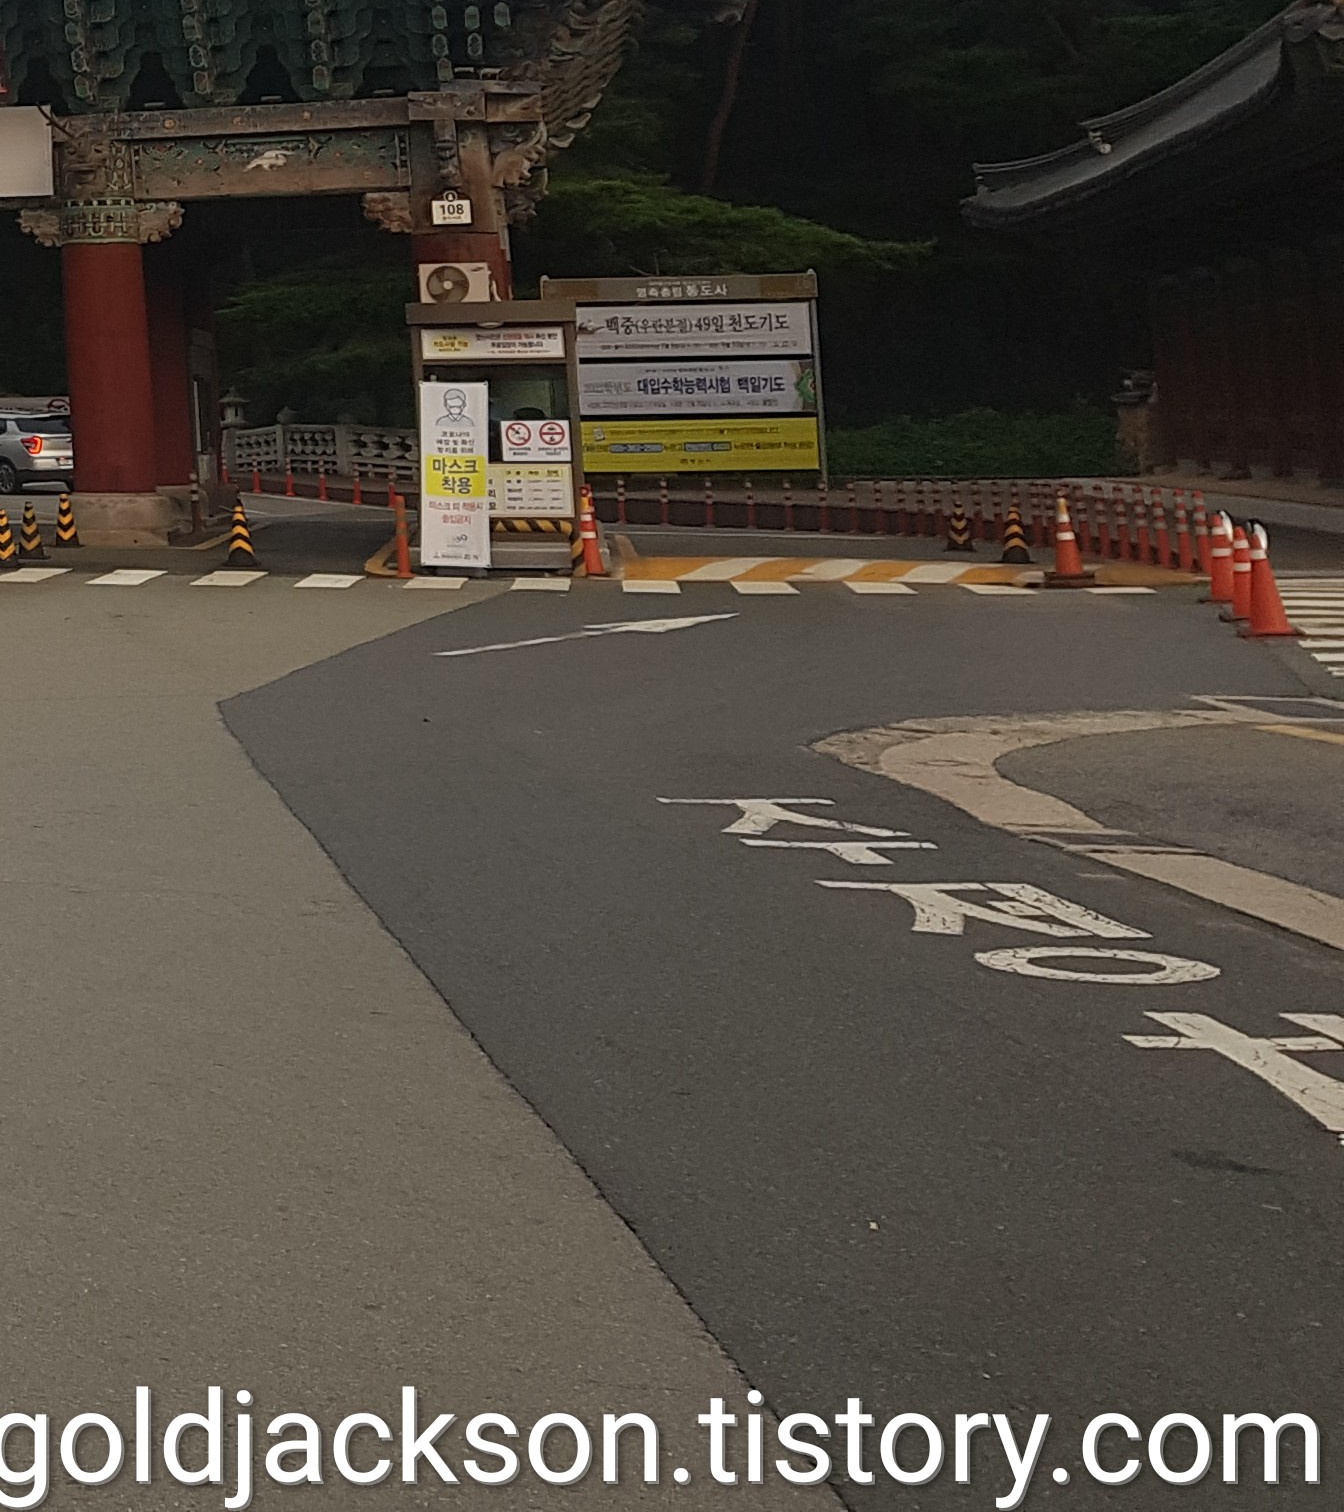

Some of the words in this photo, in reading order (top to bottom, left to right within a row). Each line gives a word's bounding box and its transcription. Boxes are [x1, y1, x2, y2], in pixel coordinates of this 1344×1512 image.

[440, 203, 465, 216] 108
[686, 283, 728, 297] 통도사
[695, 314, 725, 333] 49일
[728, 313, 790, 333] 천도기도
[637, 376, 731, 396] 대입수학능력시험
[737, 375, 786, 395] 백일기도
[432, 457, 480, 475] 마스크
[441, 475, 473, 495] 착용
